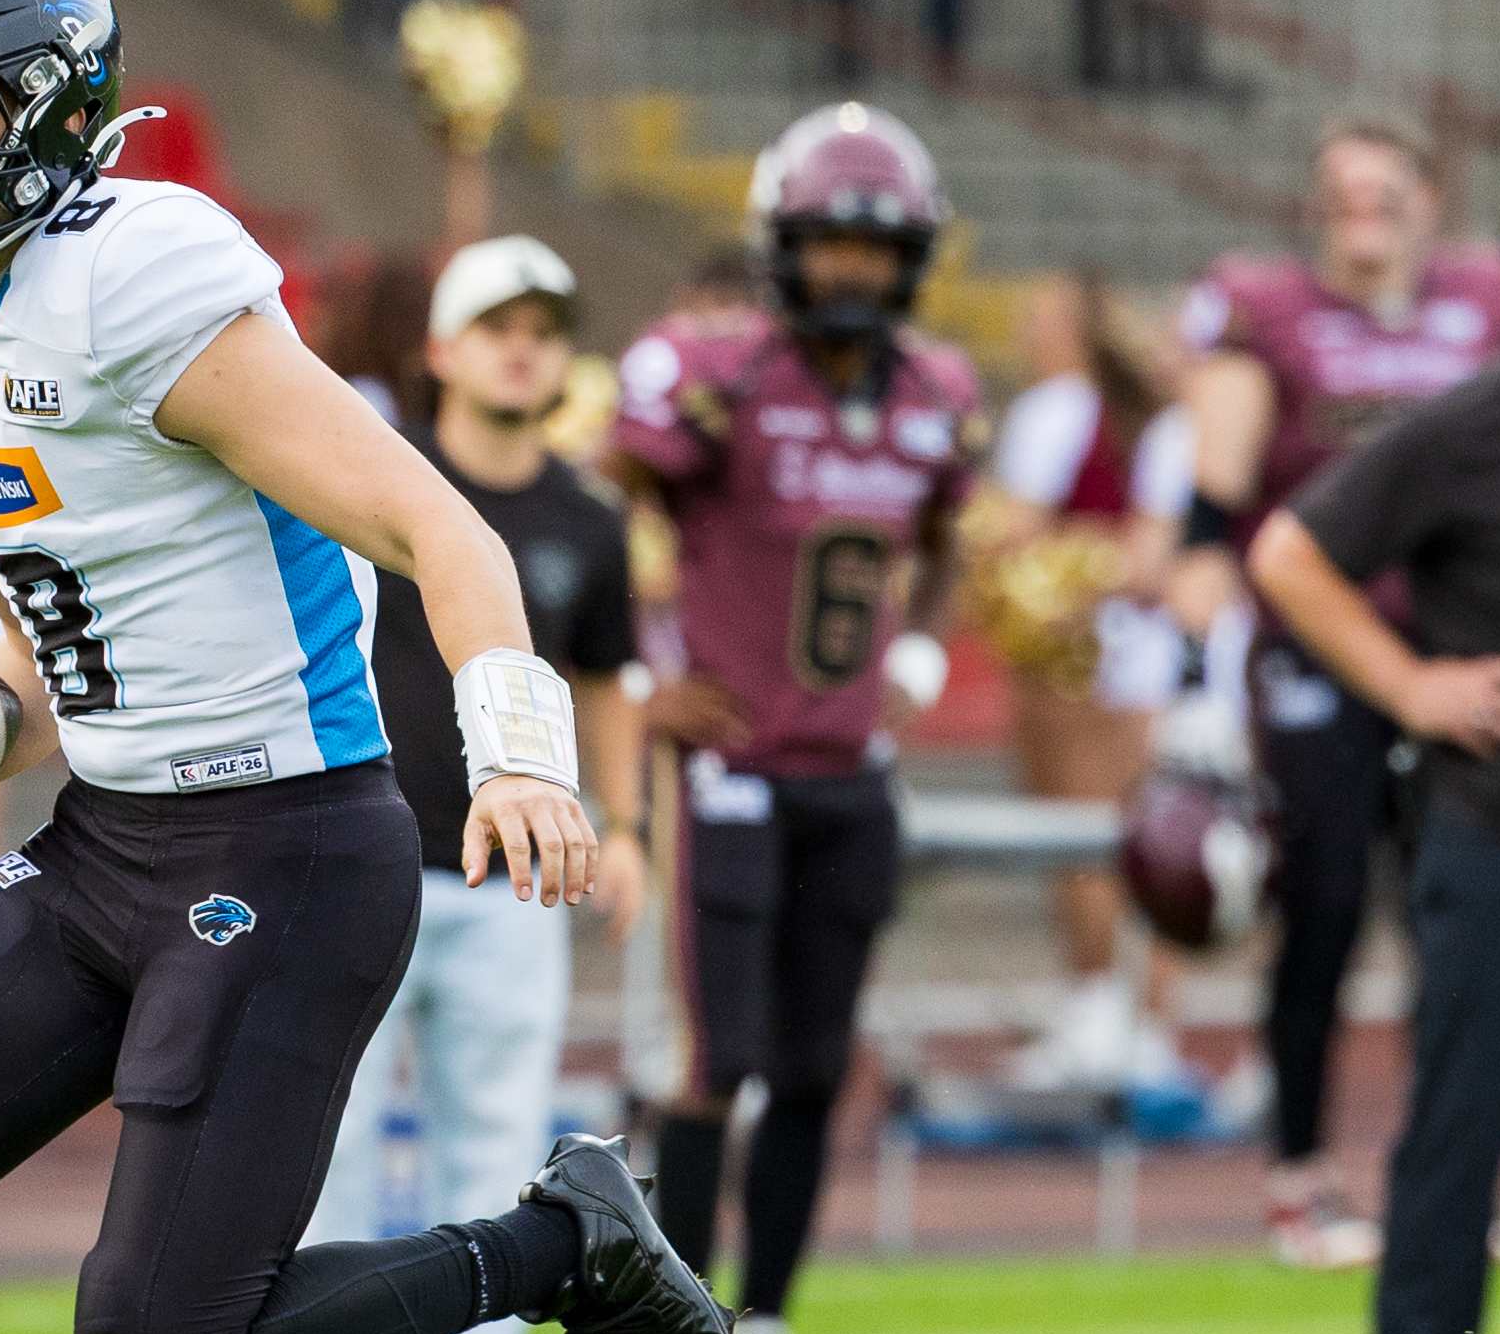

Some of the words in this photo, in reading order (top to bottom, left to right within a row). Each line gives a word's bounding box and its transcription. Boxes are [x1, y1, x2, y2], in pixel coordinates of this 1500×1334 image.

[41, 195, 121, 239] 8
[10, 379, 59, 409] AFLE
[789, 517, 889, 691] 6
[207, 760, 237, 777] AFLE
